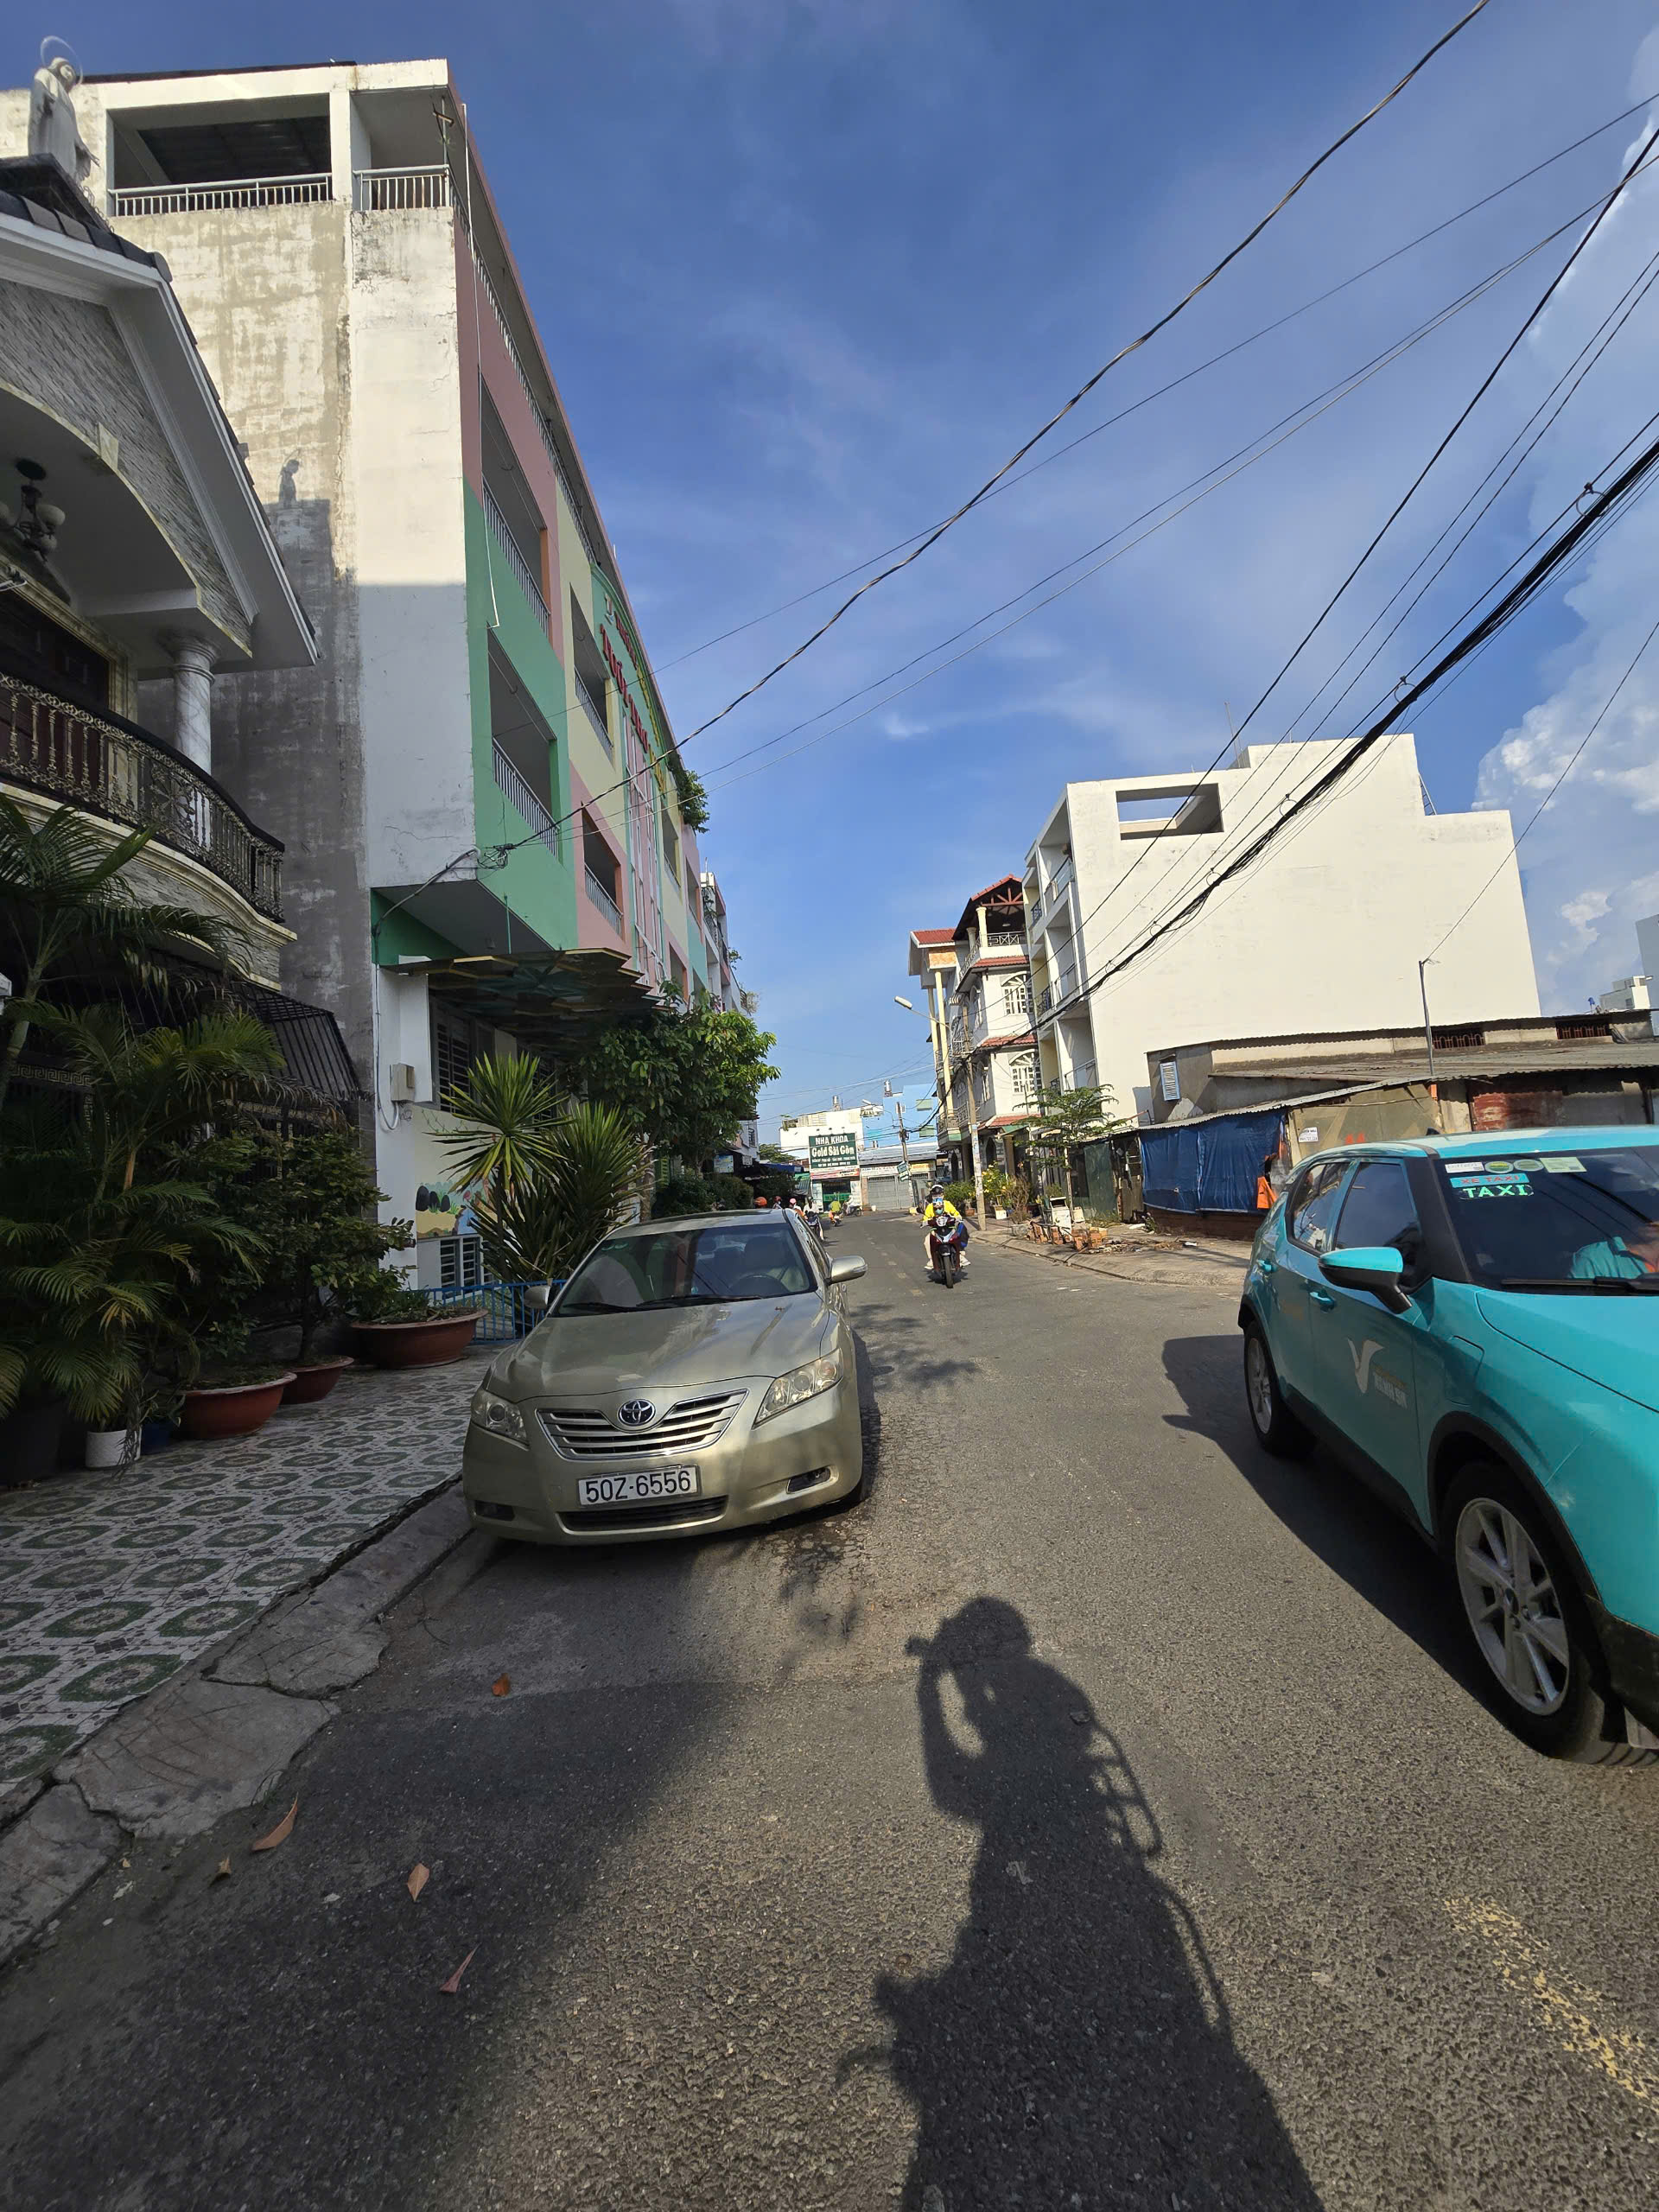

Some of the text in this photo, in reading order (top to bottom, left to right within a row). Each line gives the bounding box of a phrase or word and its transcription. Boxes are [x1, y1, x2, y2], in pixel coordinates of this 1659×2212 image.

[815, 1135, 849, 1146] NHA KHOA
[812, 1146, 828, 1158] Gold
[840, 1145, 855, 1155] Gòn
[1463, 1185, 1529, 1198] TAXI
[585, 1470, 691, 1503] 50Z-6556
